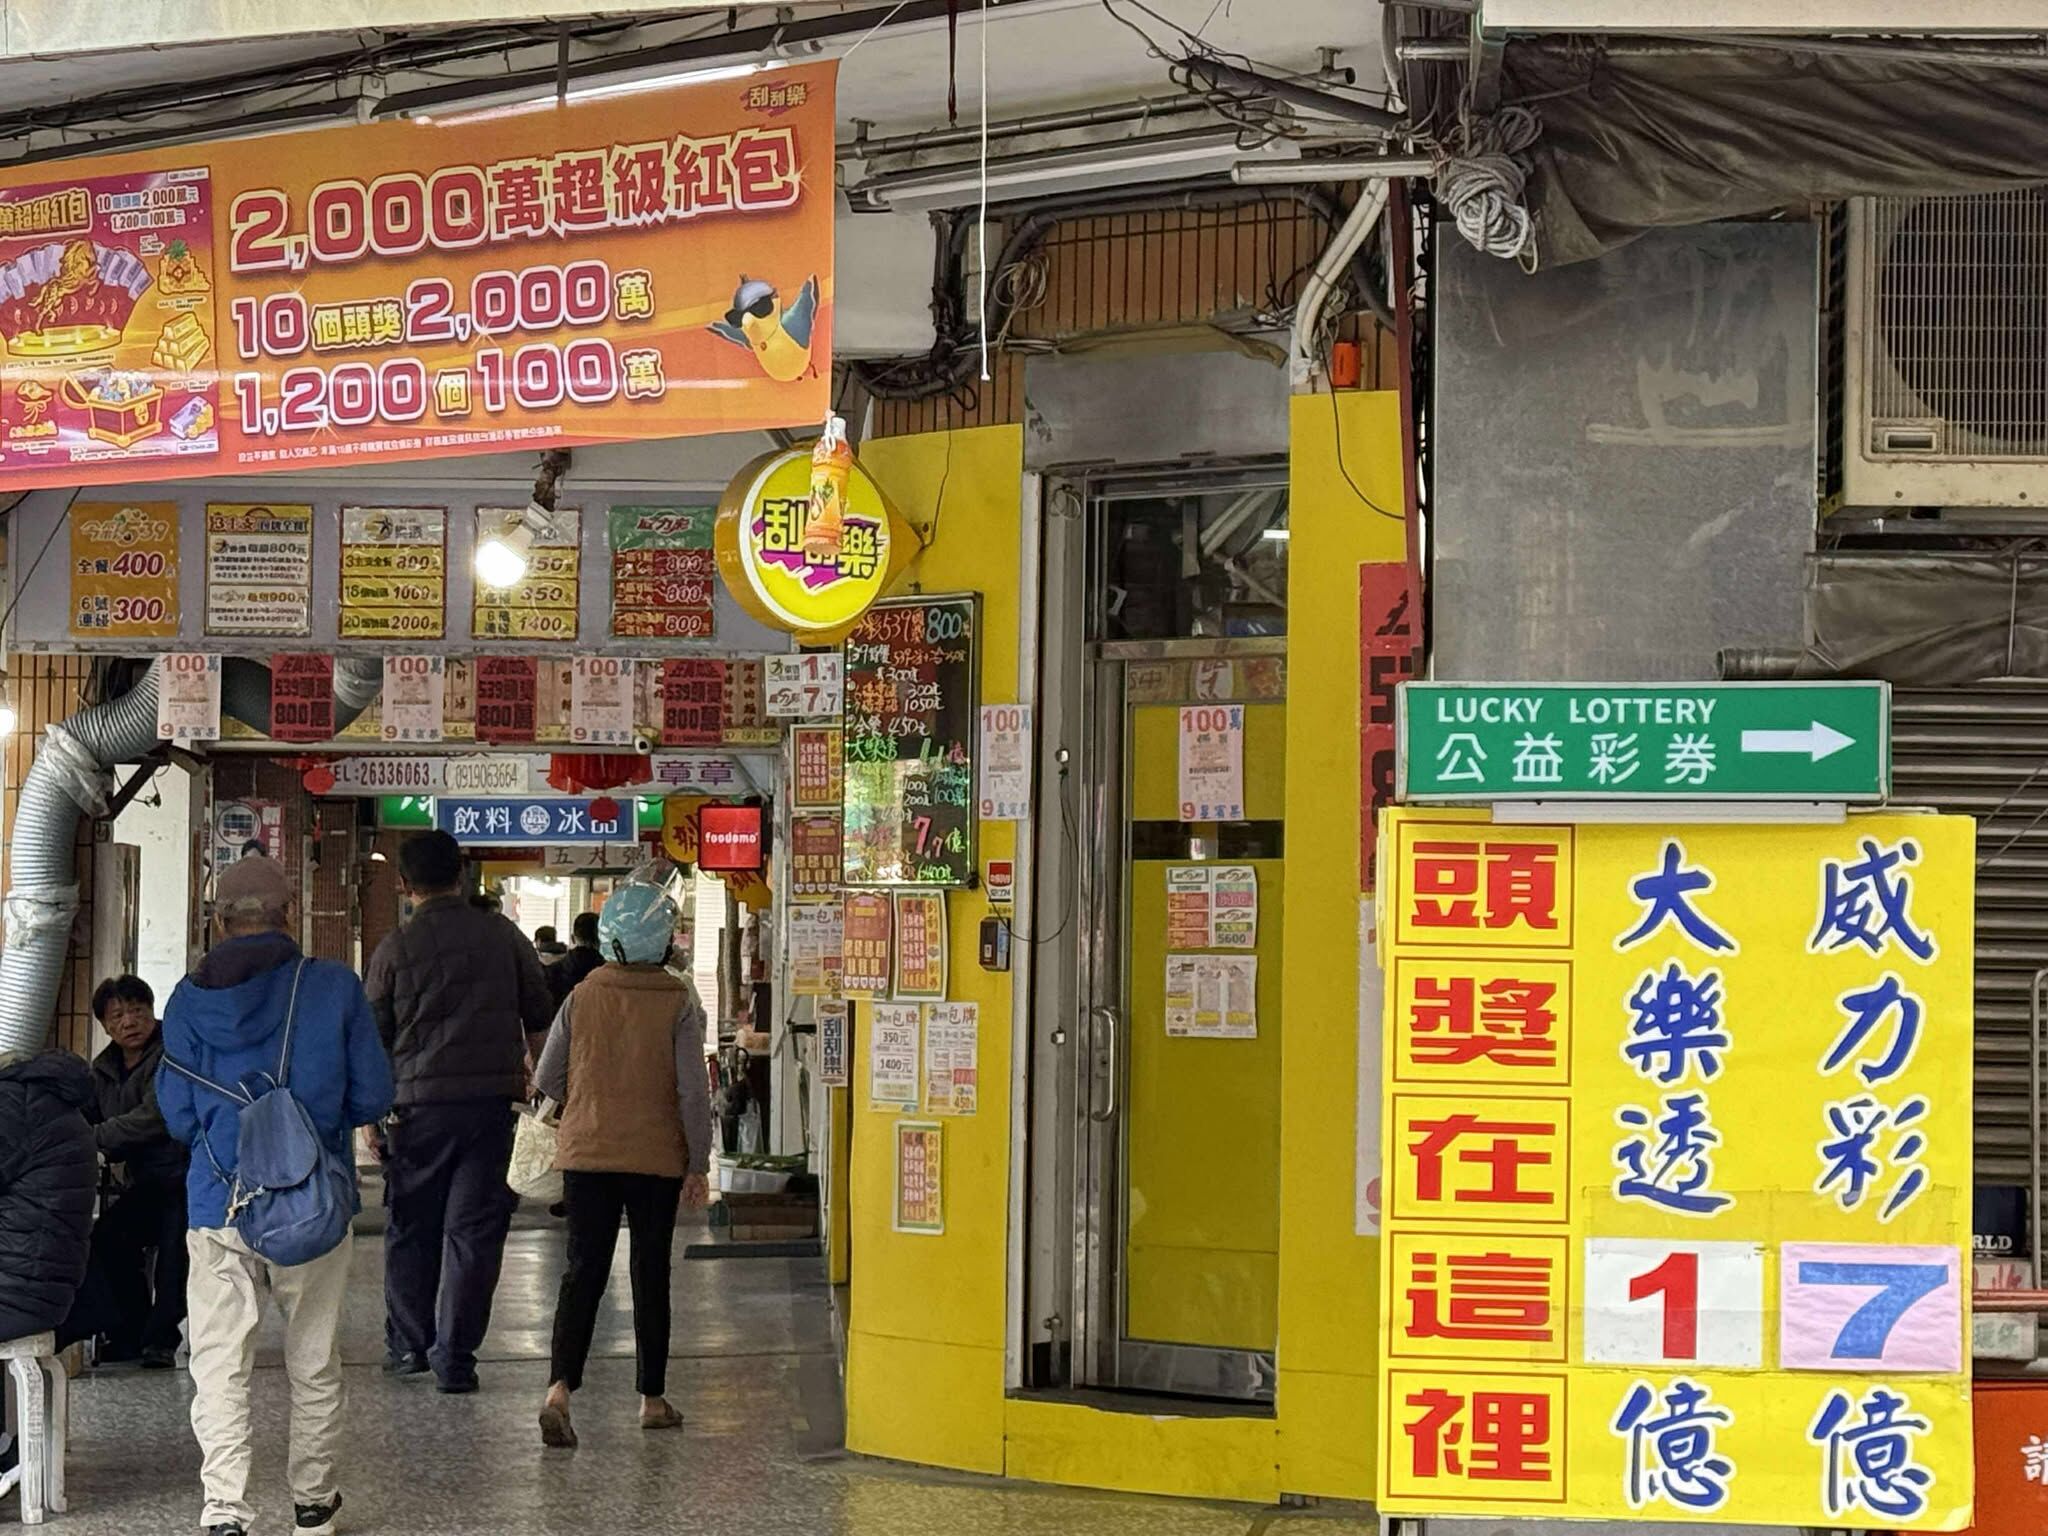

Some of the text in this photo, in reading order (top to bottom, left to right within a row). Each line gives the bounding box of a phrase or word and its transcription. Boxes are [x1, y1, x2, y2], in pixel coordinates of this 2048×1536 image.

[749, 84, 807, 108] 刮刮樂
[230, 127, 801, 272] 2,000萬超級紅包
[112, 551, 165, 578] 400
[112, 596, 165, 624] 300
[1437, 697, 1718, 725] LUCKY LOTTERY
[1436, 731, 1717, 785] 公益彩券
[455, 762, 519, 790] 0919063664
[453, 806, 513, 834] 飲料
[823, 1018, 843, 1075] 刮刮樂
[1404, 840, 1559, 1483] 頭獎在這裡
